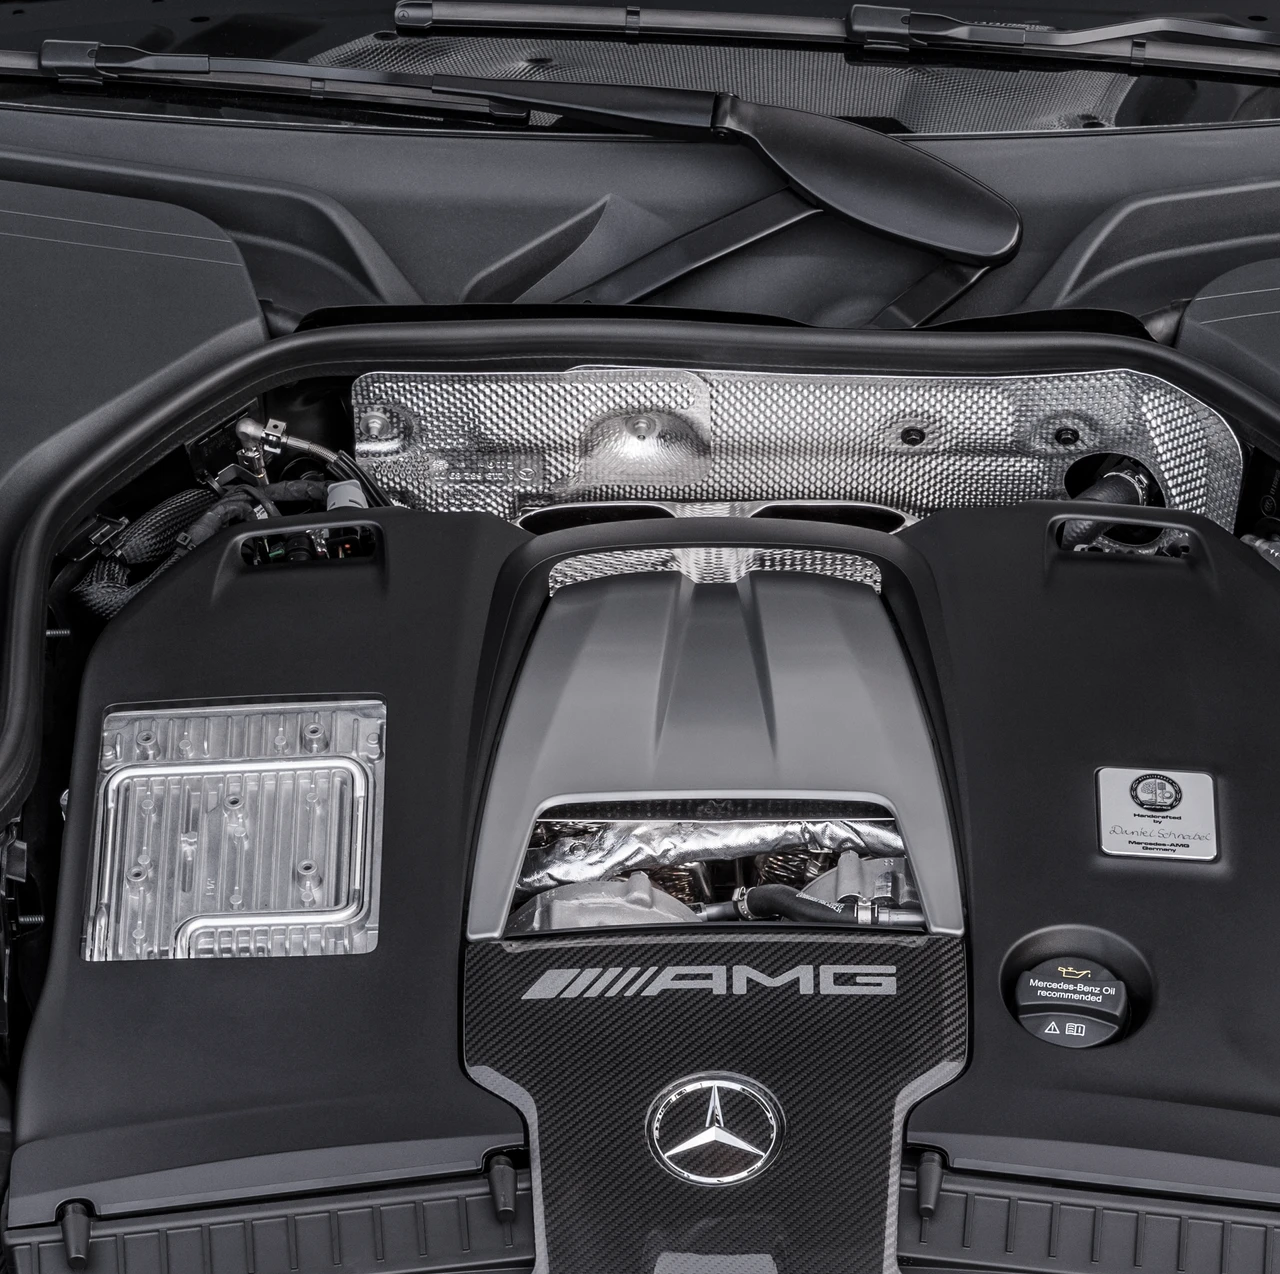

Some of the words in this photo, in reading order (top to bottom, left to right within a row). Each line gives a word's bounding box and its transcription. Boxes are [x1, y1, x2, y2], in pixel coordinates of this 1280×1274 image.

[1133, 812, 1182, 820] Handcrafted
[1109, 824, 1156, 838] Daniel
[1128, 840, 1190, 848] Mercedes-AMG
[645, 964, 898, 996] AMG
[1029, 978, 1101, 994] Mercedes-Benz
[1102, 986, 1116, 995] Oil
[1037, 989, 1102, 1002] recommended
